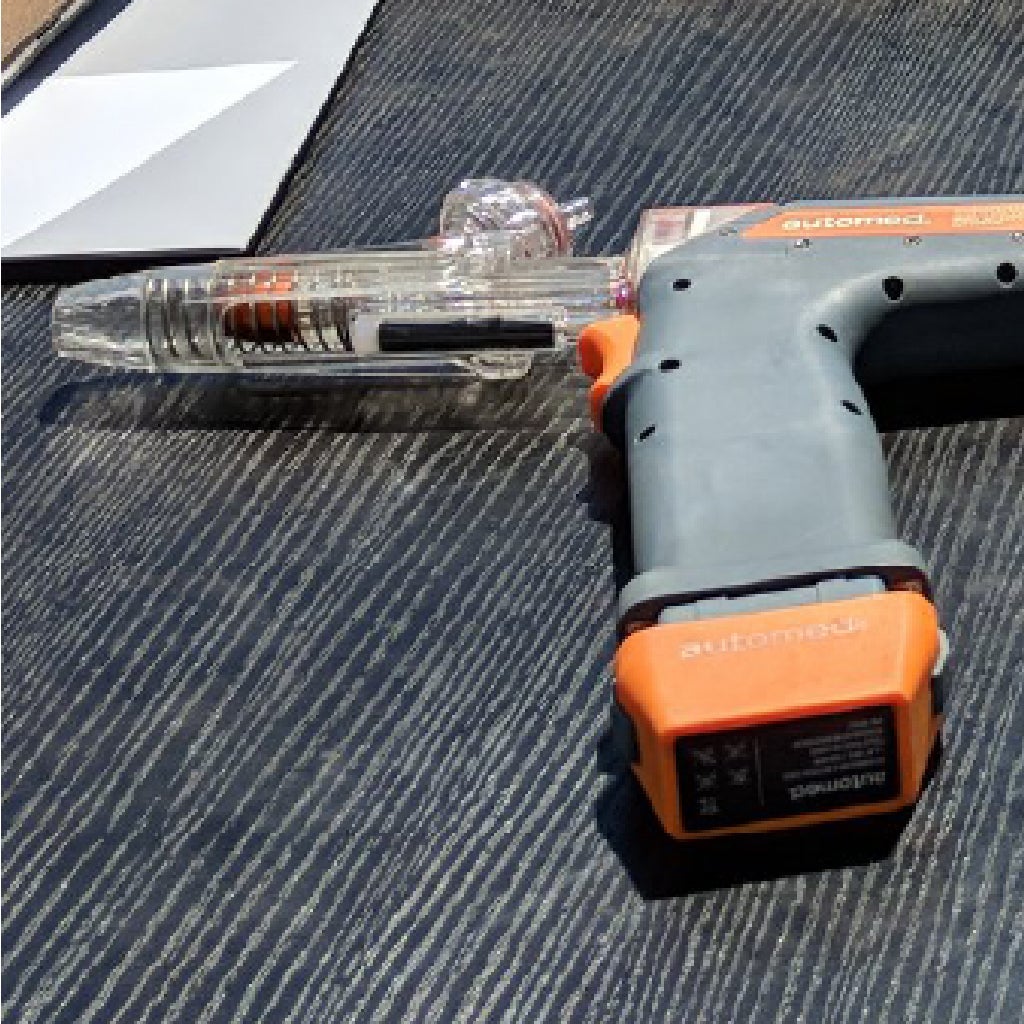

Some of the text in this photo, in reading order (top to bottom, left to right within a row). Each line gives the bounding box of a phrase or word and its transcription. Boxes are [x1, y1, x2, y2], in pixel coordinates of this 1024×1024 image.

[781, 214, 924, 231] automed
[680, 616, 854, 658] automed
[790, 771, 886, 801] automed
